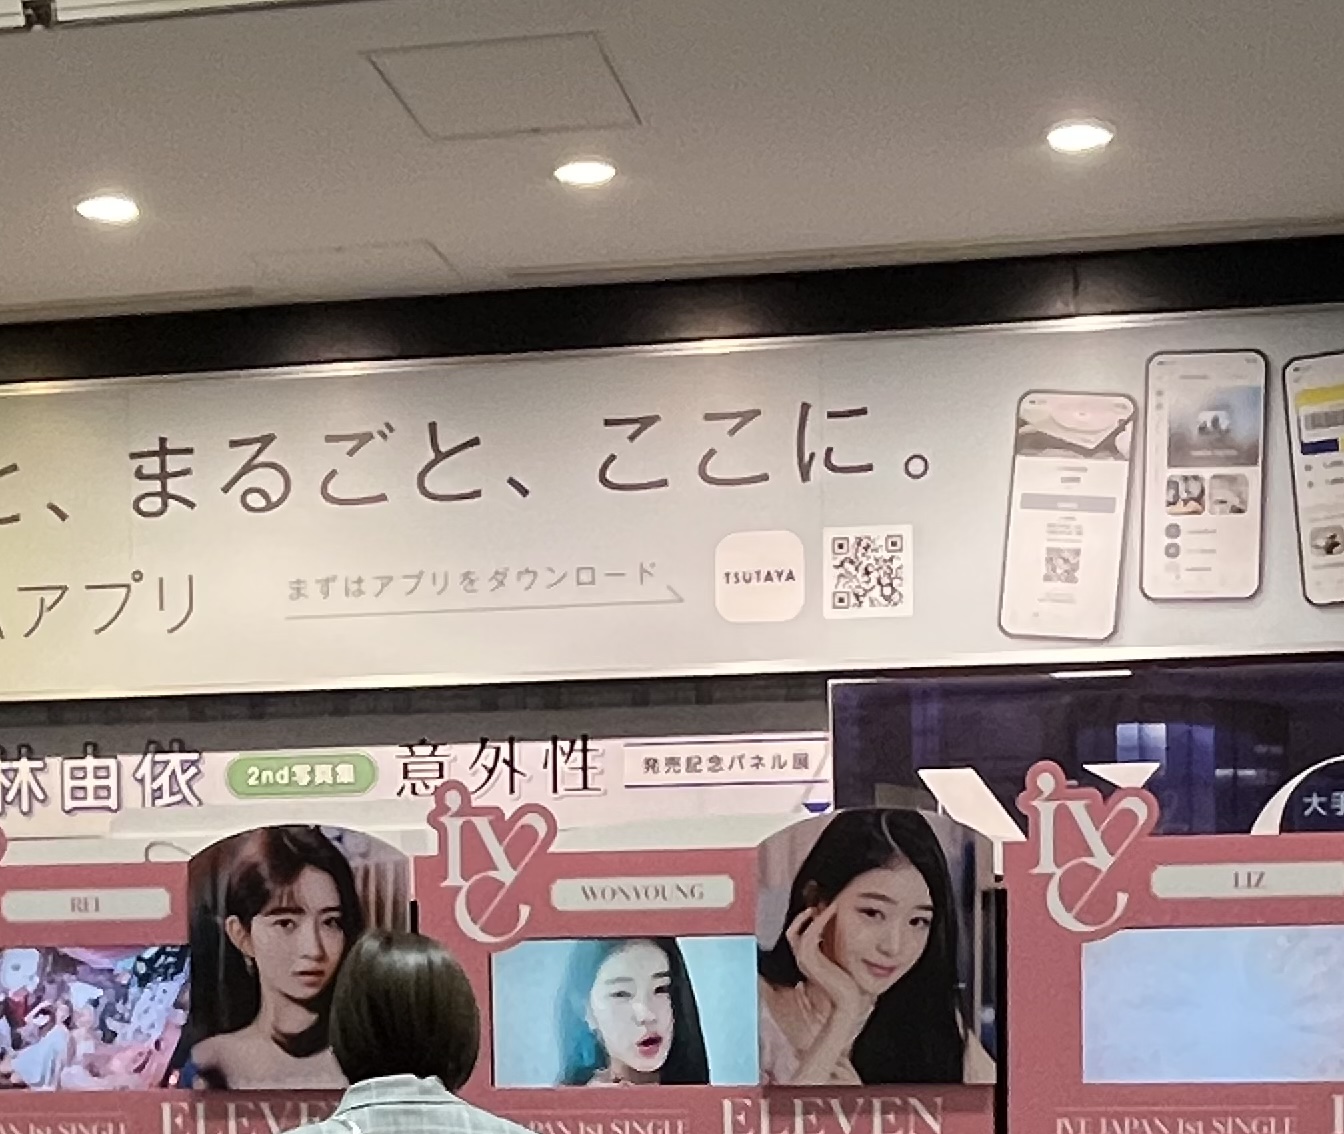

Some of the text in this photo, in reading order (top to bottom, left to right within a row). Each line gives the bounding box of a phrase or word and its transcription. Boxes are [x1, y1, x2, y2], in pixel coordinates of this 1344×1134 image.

[288, 561, 658, 602] まずはアプリをダウンロード
[724, 568, 797, 586] TSUTAYA
[396, 734, 604, 797] 意外性
[643, 752, 811, 775] 発売記念パネル展
[1233, 871, 1266, 889] LIZ
[581, 883, 704, 903] WONYOUNG
